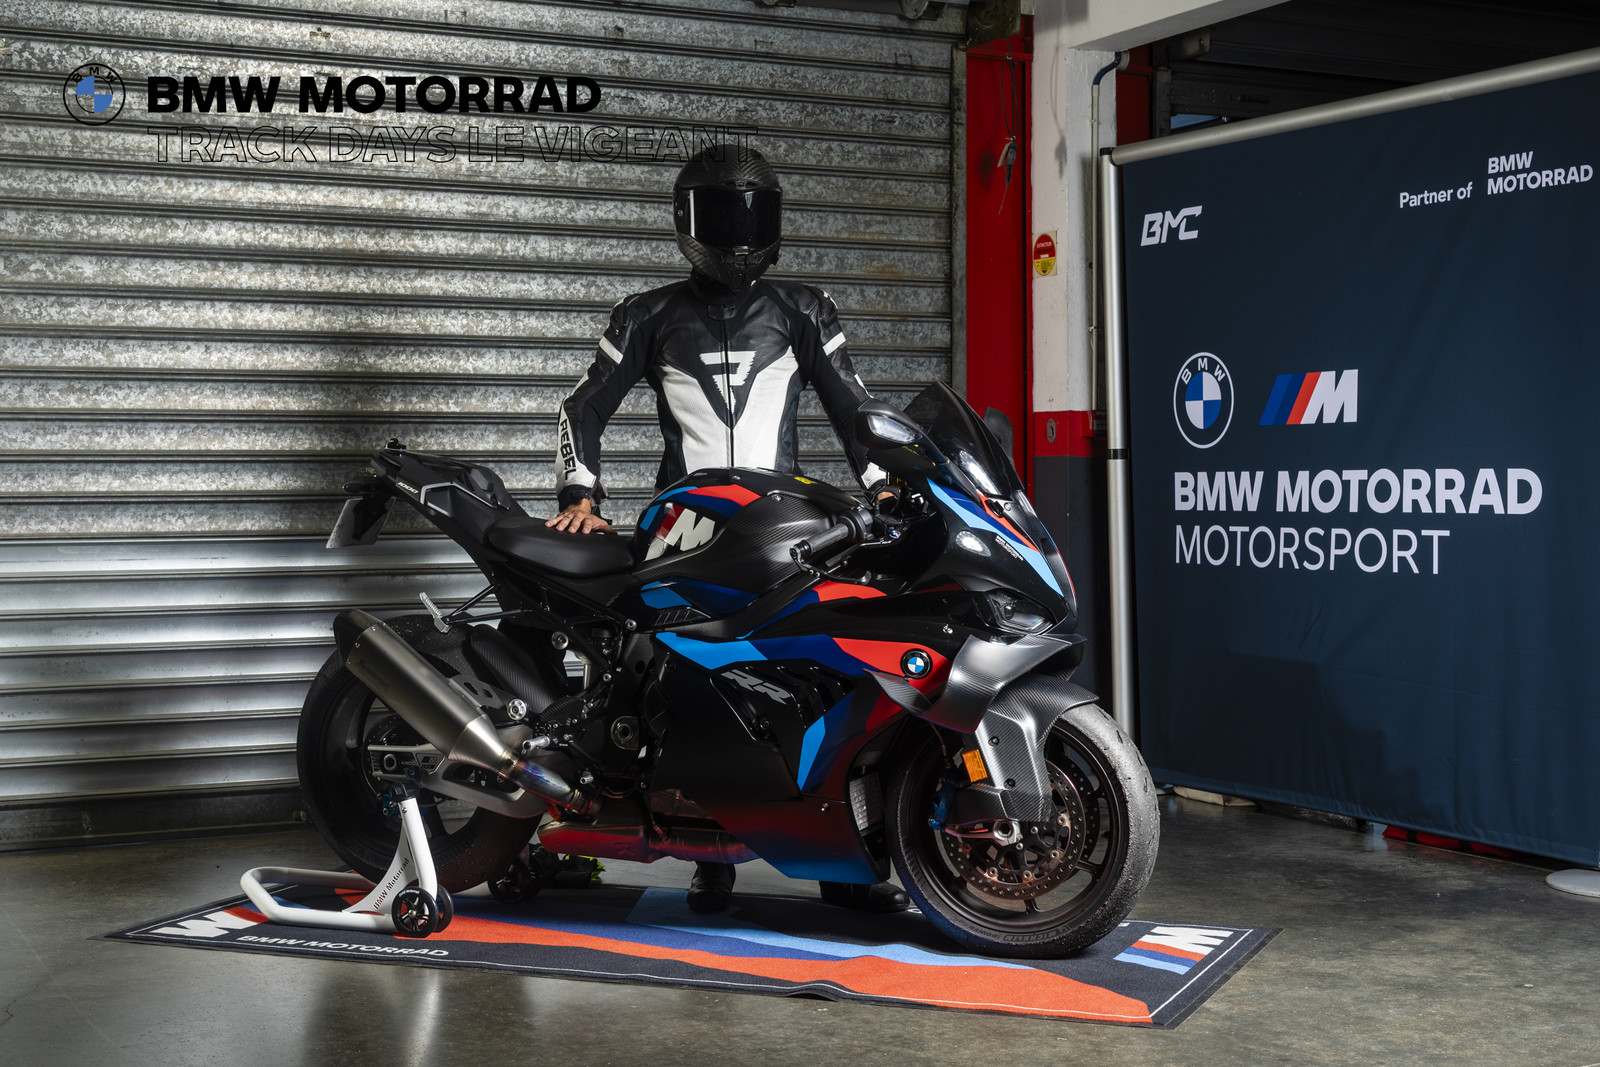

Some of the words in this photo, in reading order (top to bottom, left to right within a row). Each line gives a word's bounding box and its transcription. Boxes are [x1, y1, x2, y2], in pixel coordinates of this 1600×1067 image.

[1487, 151, 1533, 174] BMW
[1399, 186, 1453, 209] Partner
[1456, 182, 1473, 201] of
[1487, 164, 1594, 196] MOTORRAD
[1140, 205, 1203, 247] BMC
[1181, 357, 1226, 385] BMW
[559, 418, 577, 481] REBEL
[1174, 471, 1265, 512] BMW
[1276, 467, 1543, 515] MOTORRAD
[1175, 524, 1451, 575] MOTORSPORT
[386, 857, 410, 892] Motorrad
[236, 935, 306, 946] BMW
[303, 941, 450, 957] MOTORRAD
[1004, 931, 1057, 942] MICHELIN
